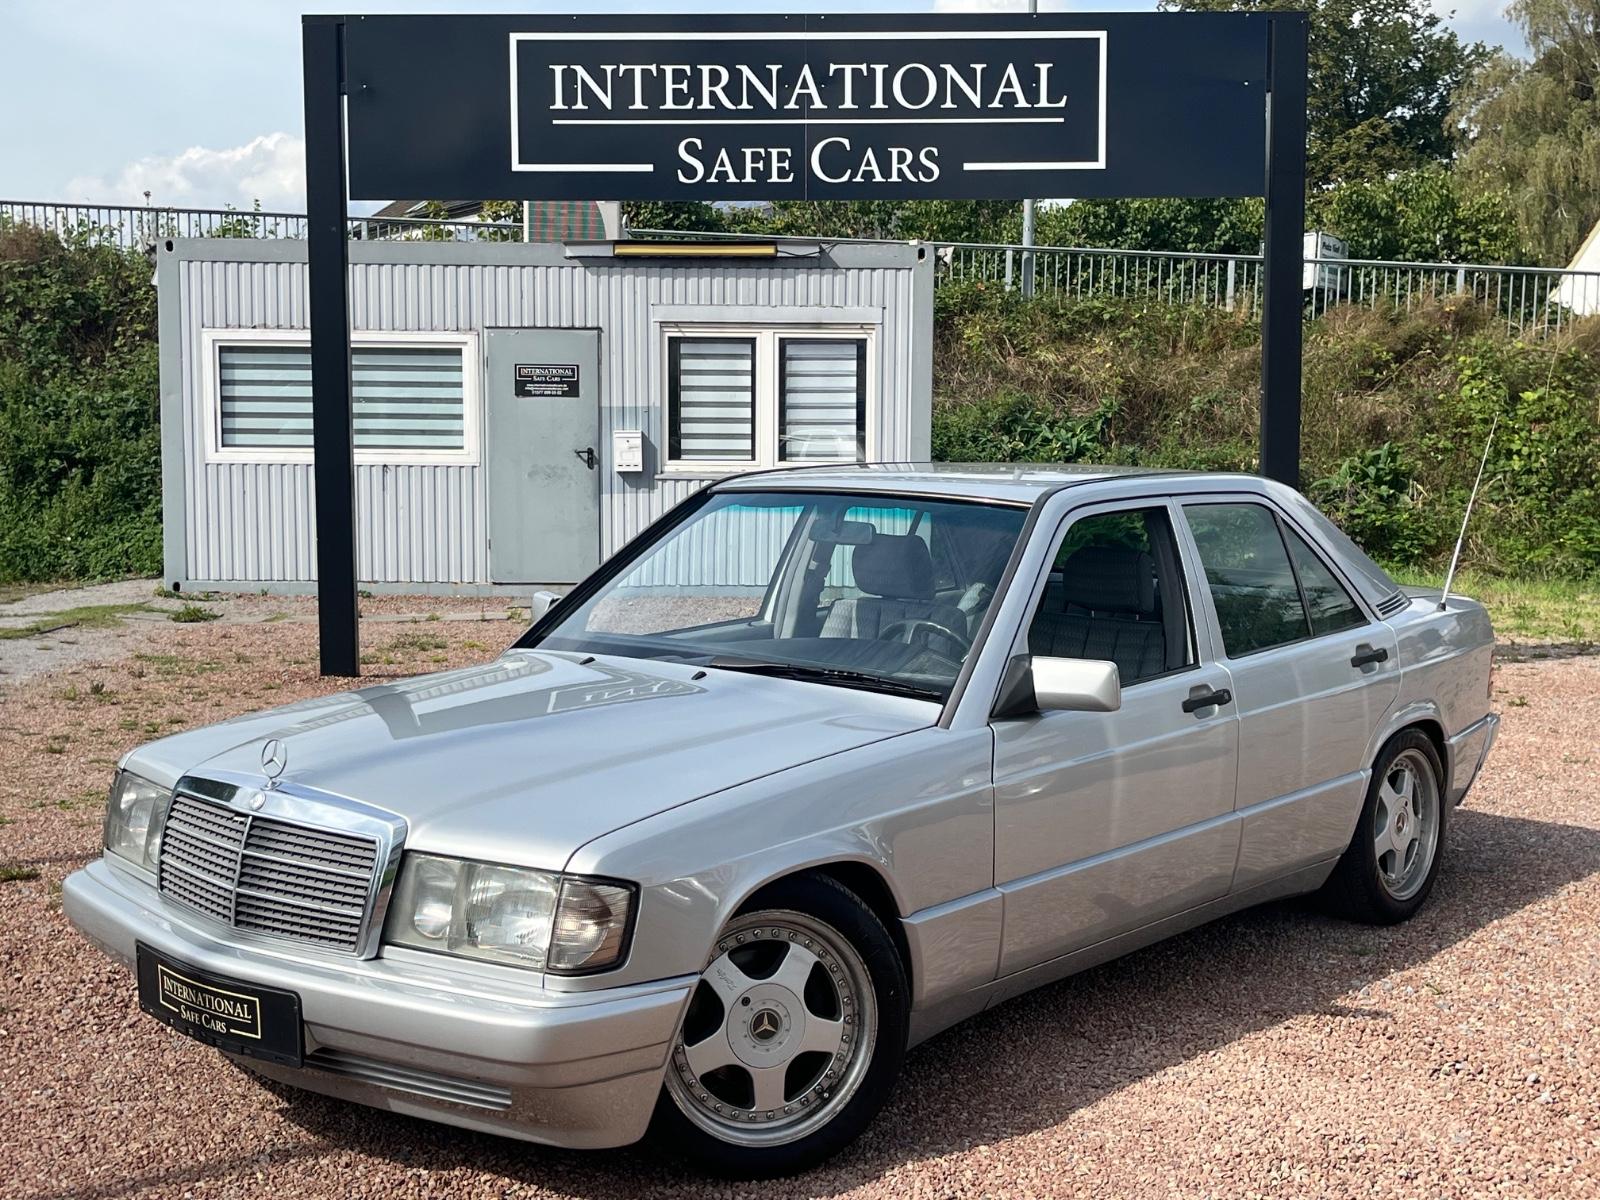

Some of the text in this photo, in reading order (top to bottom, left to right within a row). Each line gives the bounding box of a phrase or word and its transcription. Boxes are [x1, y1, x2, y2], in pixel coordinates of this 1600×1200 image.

[548, 62, 1068, 111] INTERNATIONAL
[676, 136, 941, 185] SAFE CARS
[163, 975, 252, 1019] INTERNATIONAL
[180, 1004, 227, 1034] SAFE CARS
